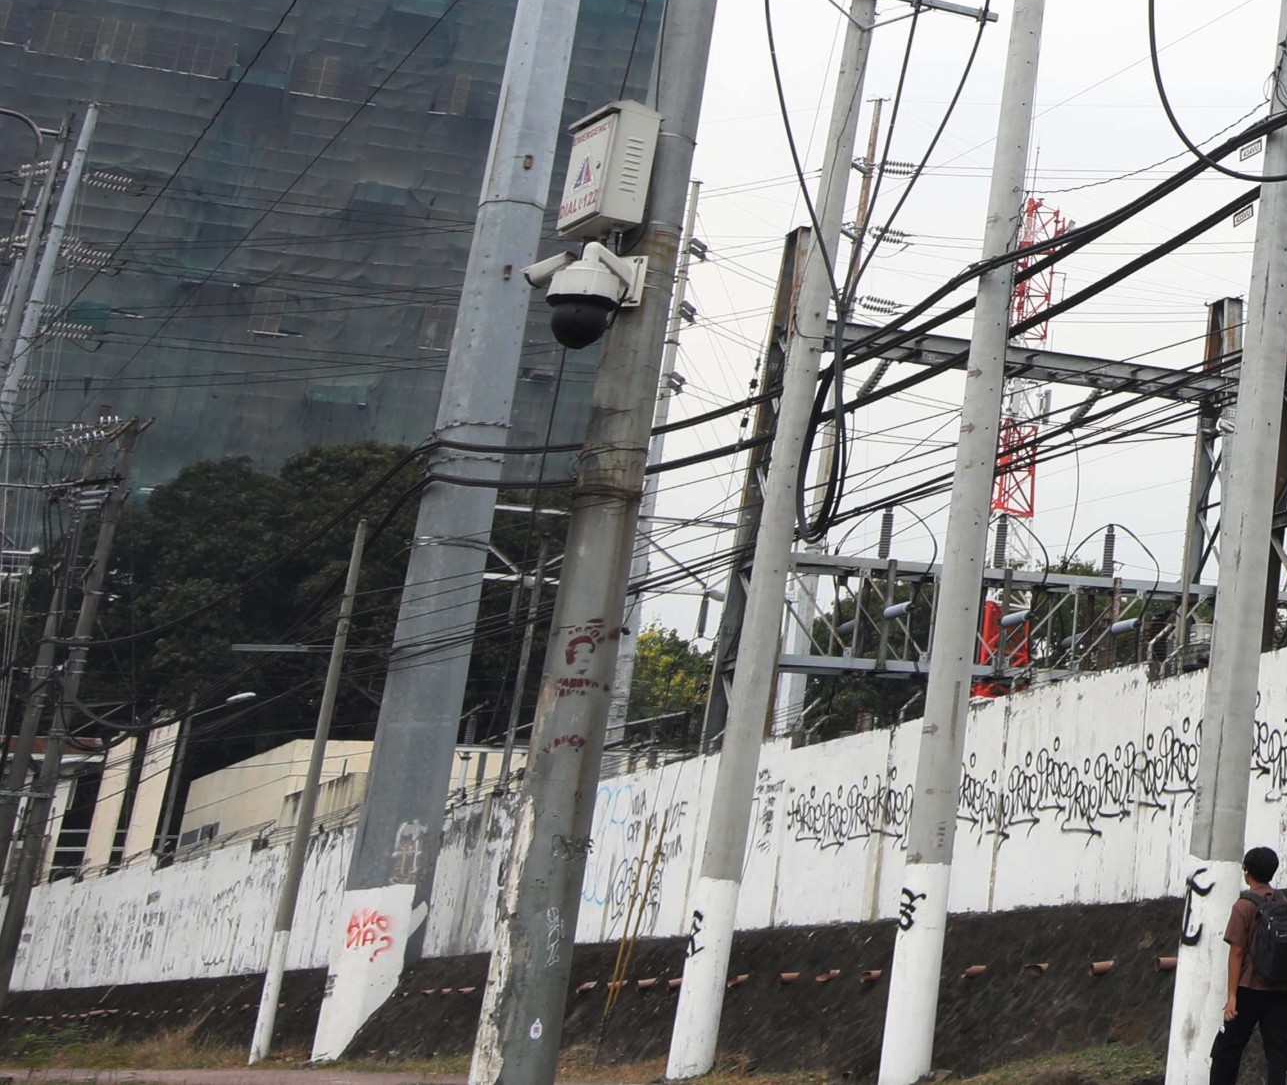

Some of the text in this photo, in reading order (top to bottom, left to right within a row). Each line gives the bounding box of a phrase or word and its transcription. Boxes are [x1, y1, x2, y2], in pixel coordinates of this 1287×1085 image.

[572, 121, 613, 147] EMERGENCY
[559, 189, 600, 220] DIAL 122
